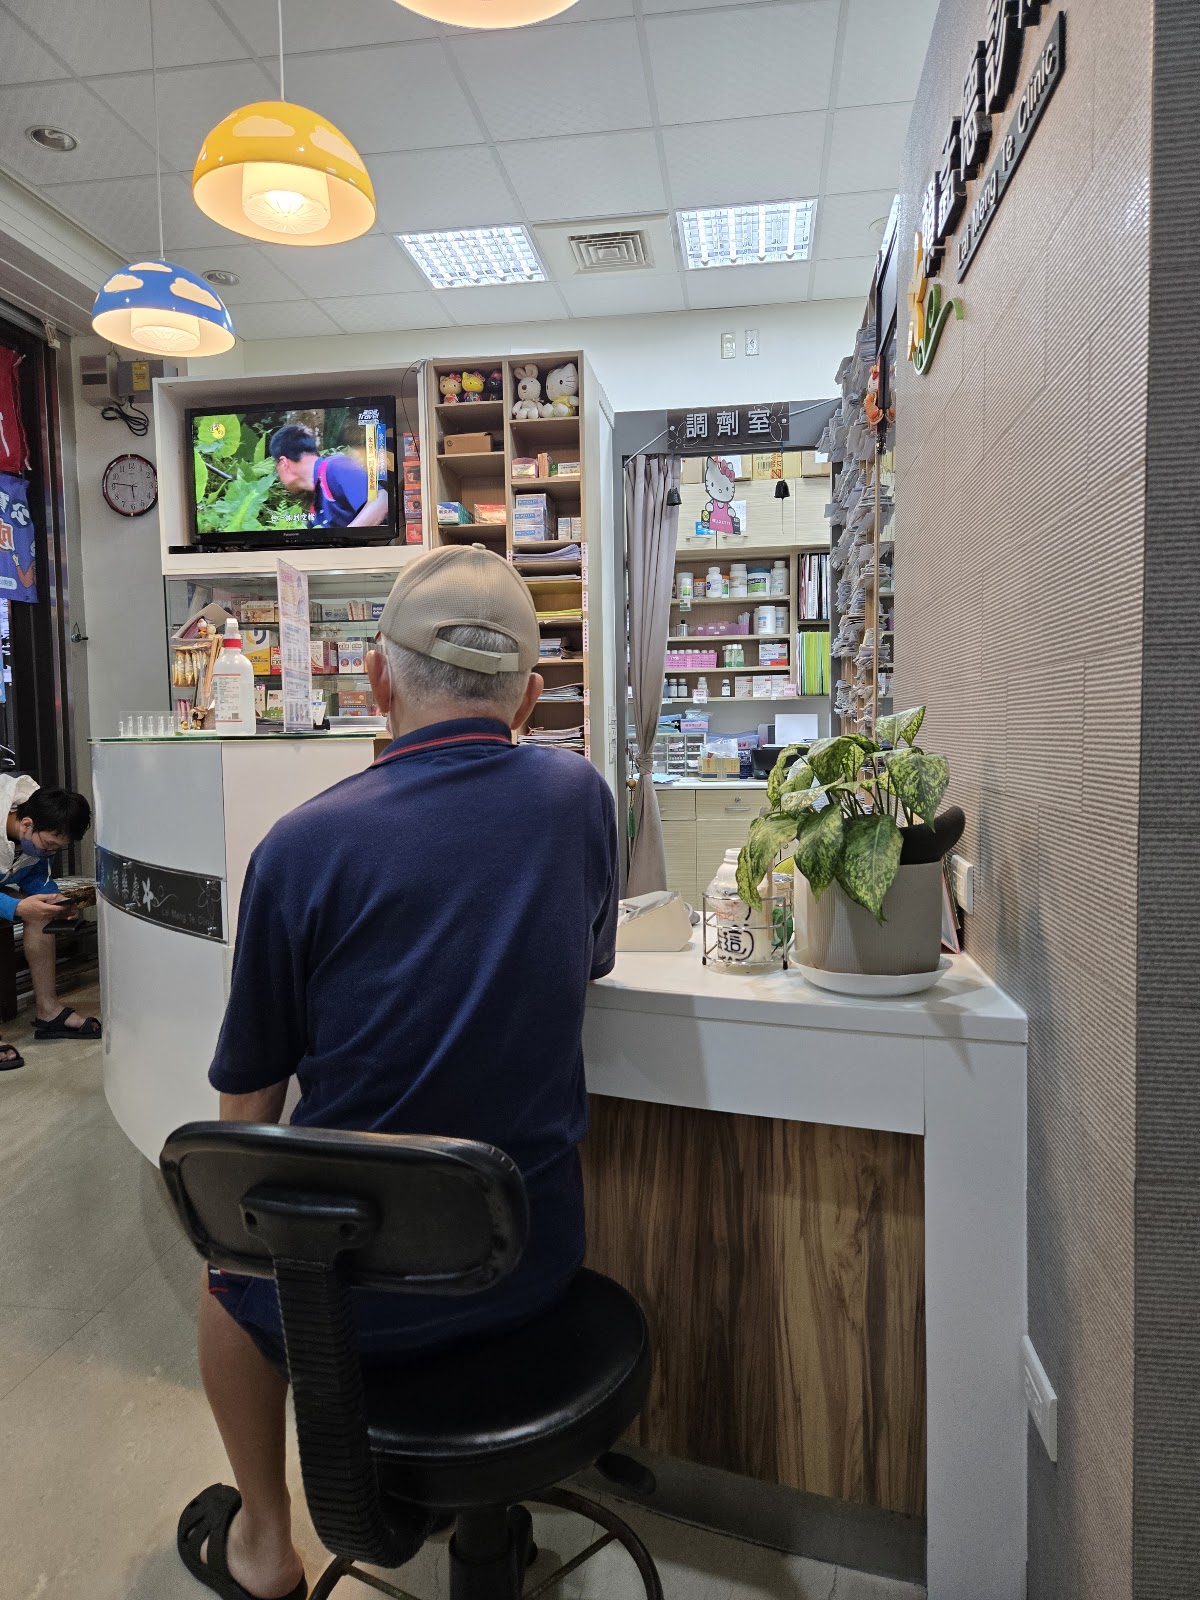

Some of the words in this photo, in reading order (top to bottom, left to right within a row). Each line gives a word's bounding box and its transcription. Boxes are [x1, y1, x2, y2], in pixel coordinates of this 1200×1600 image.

[920, 0, 1042, 278] 賴孟德診
[956, 226, 972, 270] Lai
[971, 170, 999, 238] Meng
[999, 134, 1016, 172] Te
[1016, 43, 1057, 134] Clinic
[686, 409, 771, 438] 調劑室
